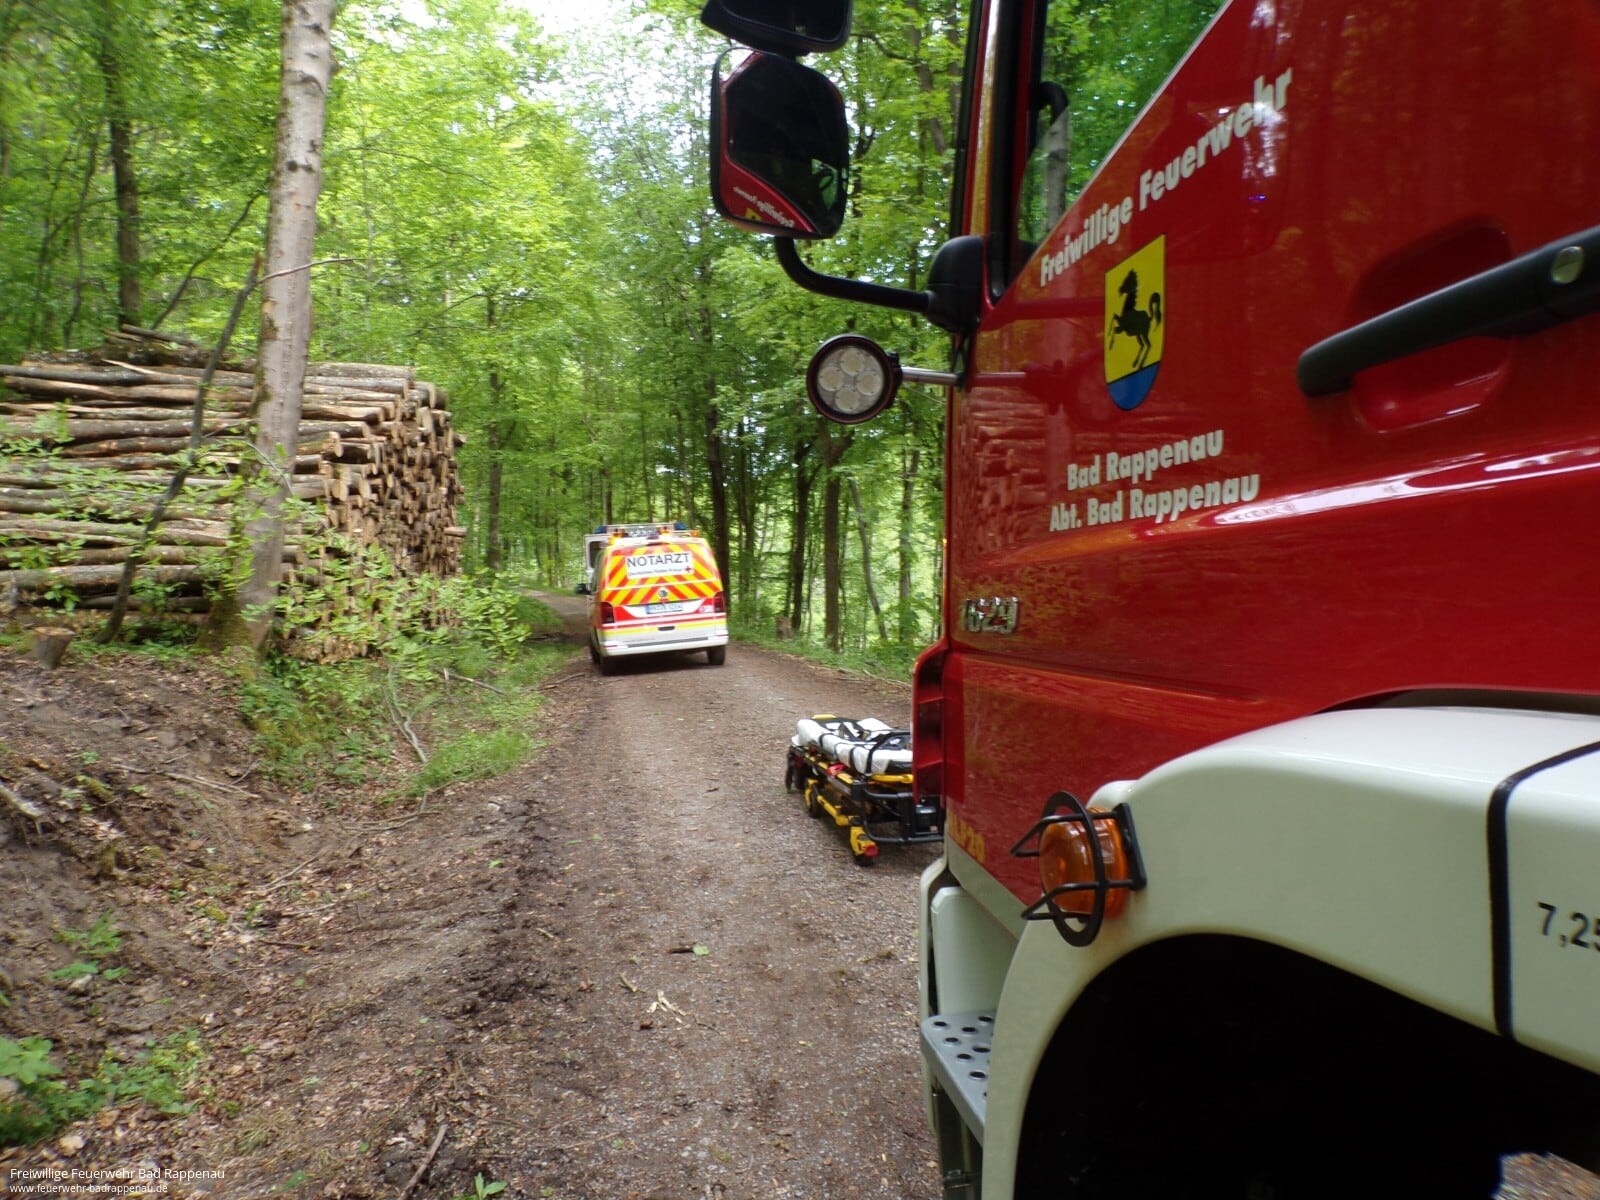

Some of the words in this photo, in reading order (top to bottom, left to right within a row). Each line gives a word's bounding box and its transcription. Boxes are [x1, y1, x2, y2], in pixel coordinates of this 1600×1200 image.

[1040, 196, 1133, 287] Freiwillige
[1139, 67, 1293, 211] Feuerwehr
[1067, 455, 1100, 491] Bad
[1106, 429, 1224, 484] Rappenau
[1049, 502, 1082, 532] Abt.
[1087, 490, 1123, 526] Bad
[1129, 473, 1260, 523] Rappenau
[627, 553, 689, 567] NOTARZT
